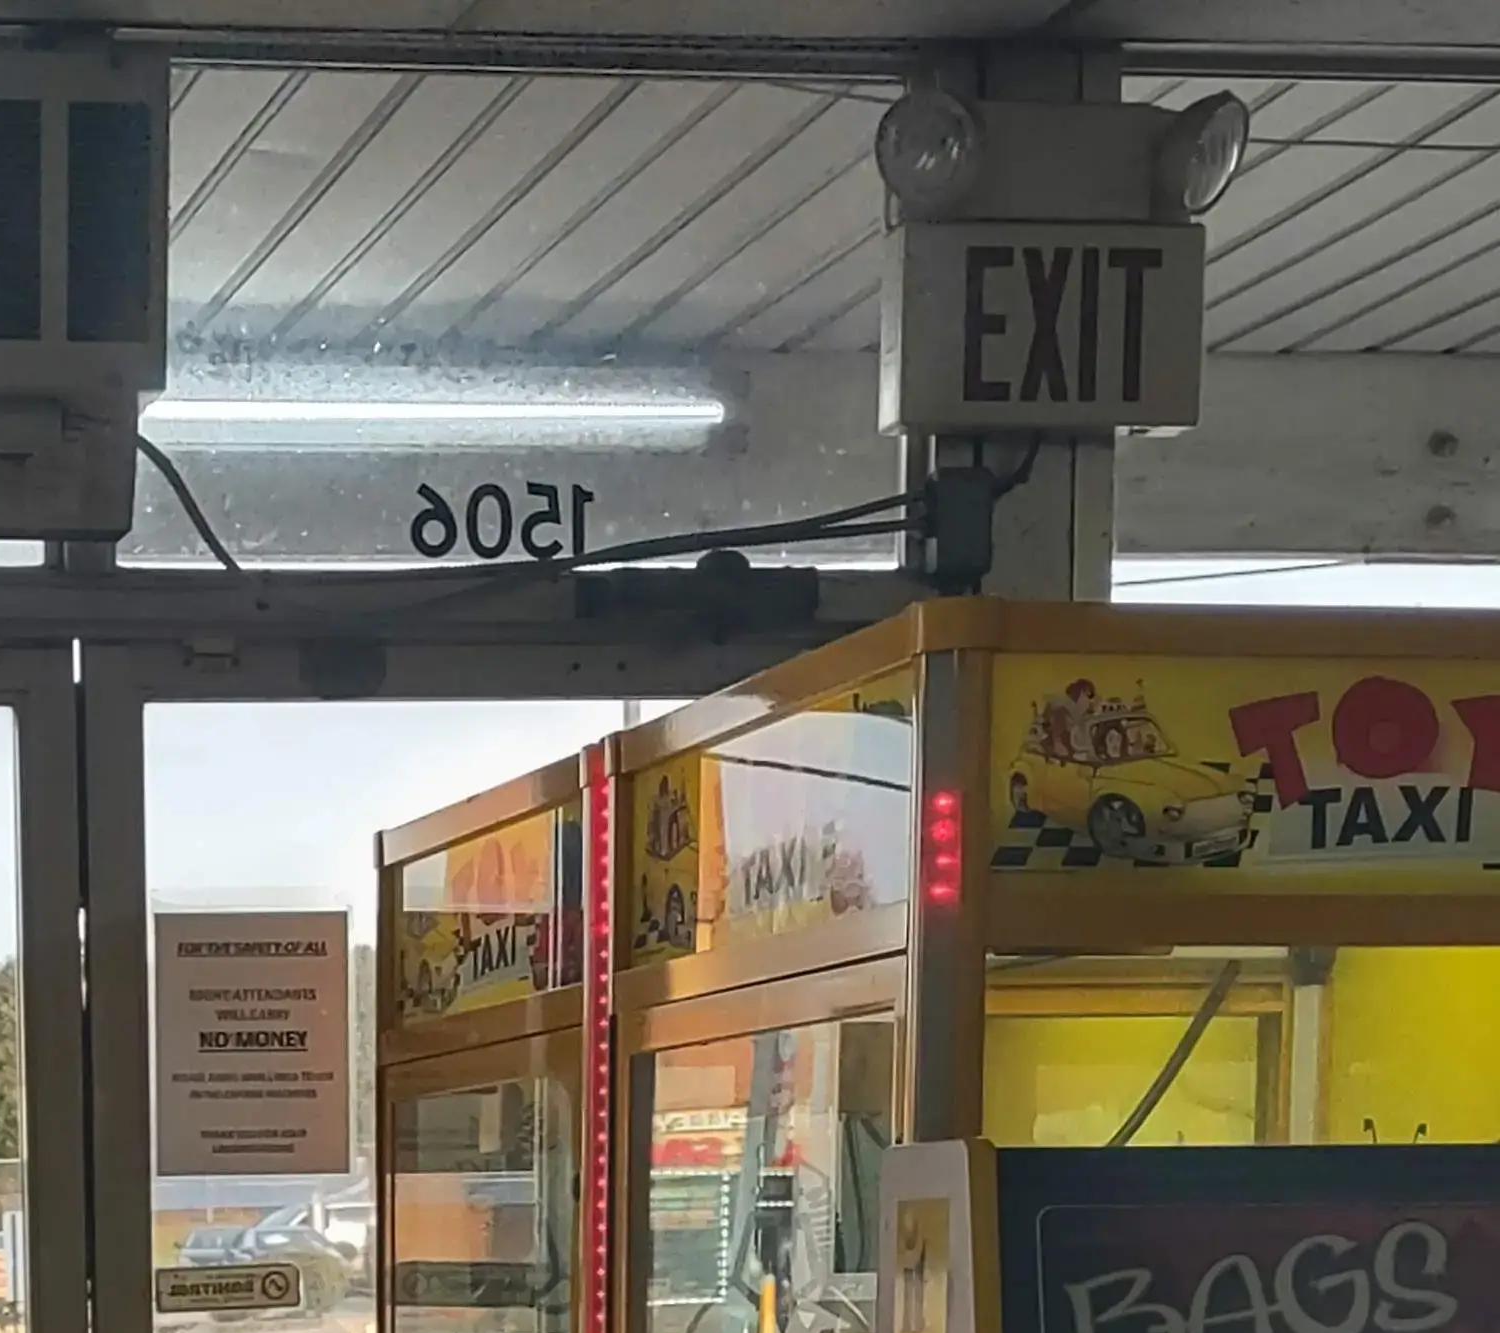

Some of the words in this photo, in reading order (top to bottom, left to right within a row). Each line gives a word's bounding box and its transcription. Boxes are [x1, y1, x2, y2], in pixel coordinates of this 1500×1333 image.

[962, 246, 1162, 403] EXIT
[1297, 786, 1474, 849] TAXI
[468, 925, 516, 981] TAXI
[199, 1032, 230, 1049] NO
[235, 1031, 308, 1048] MONEY
